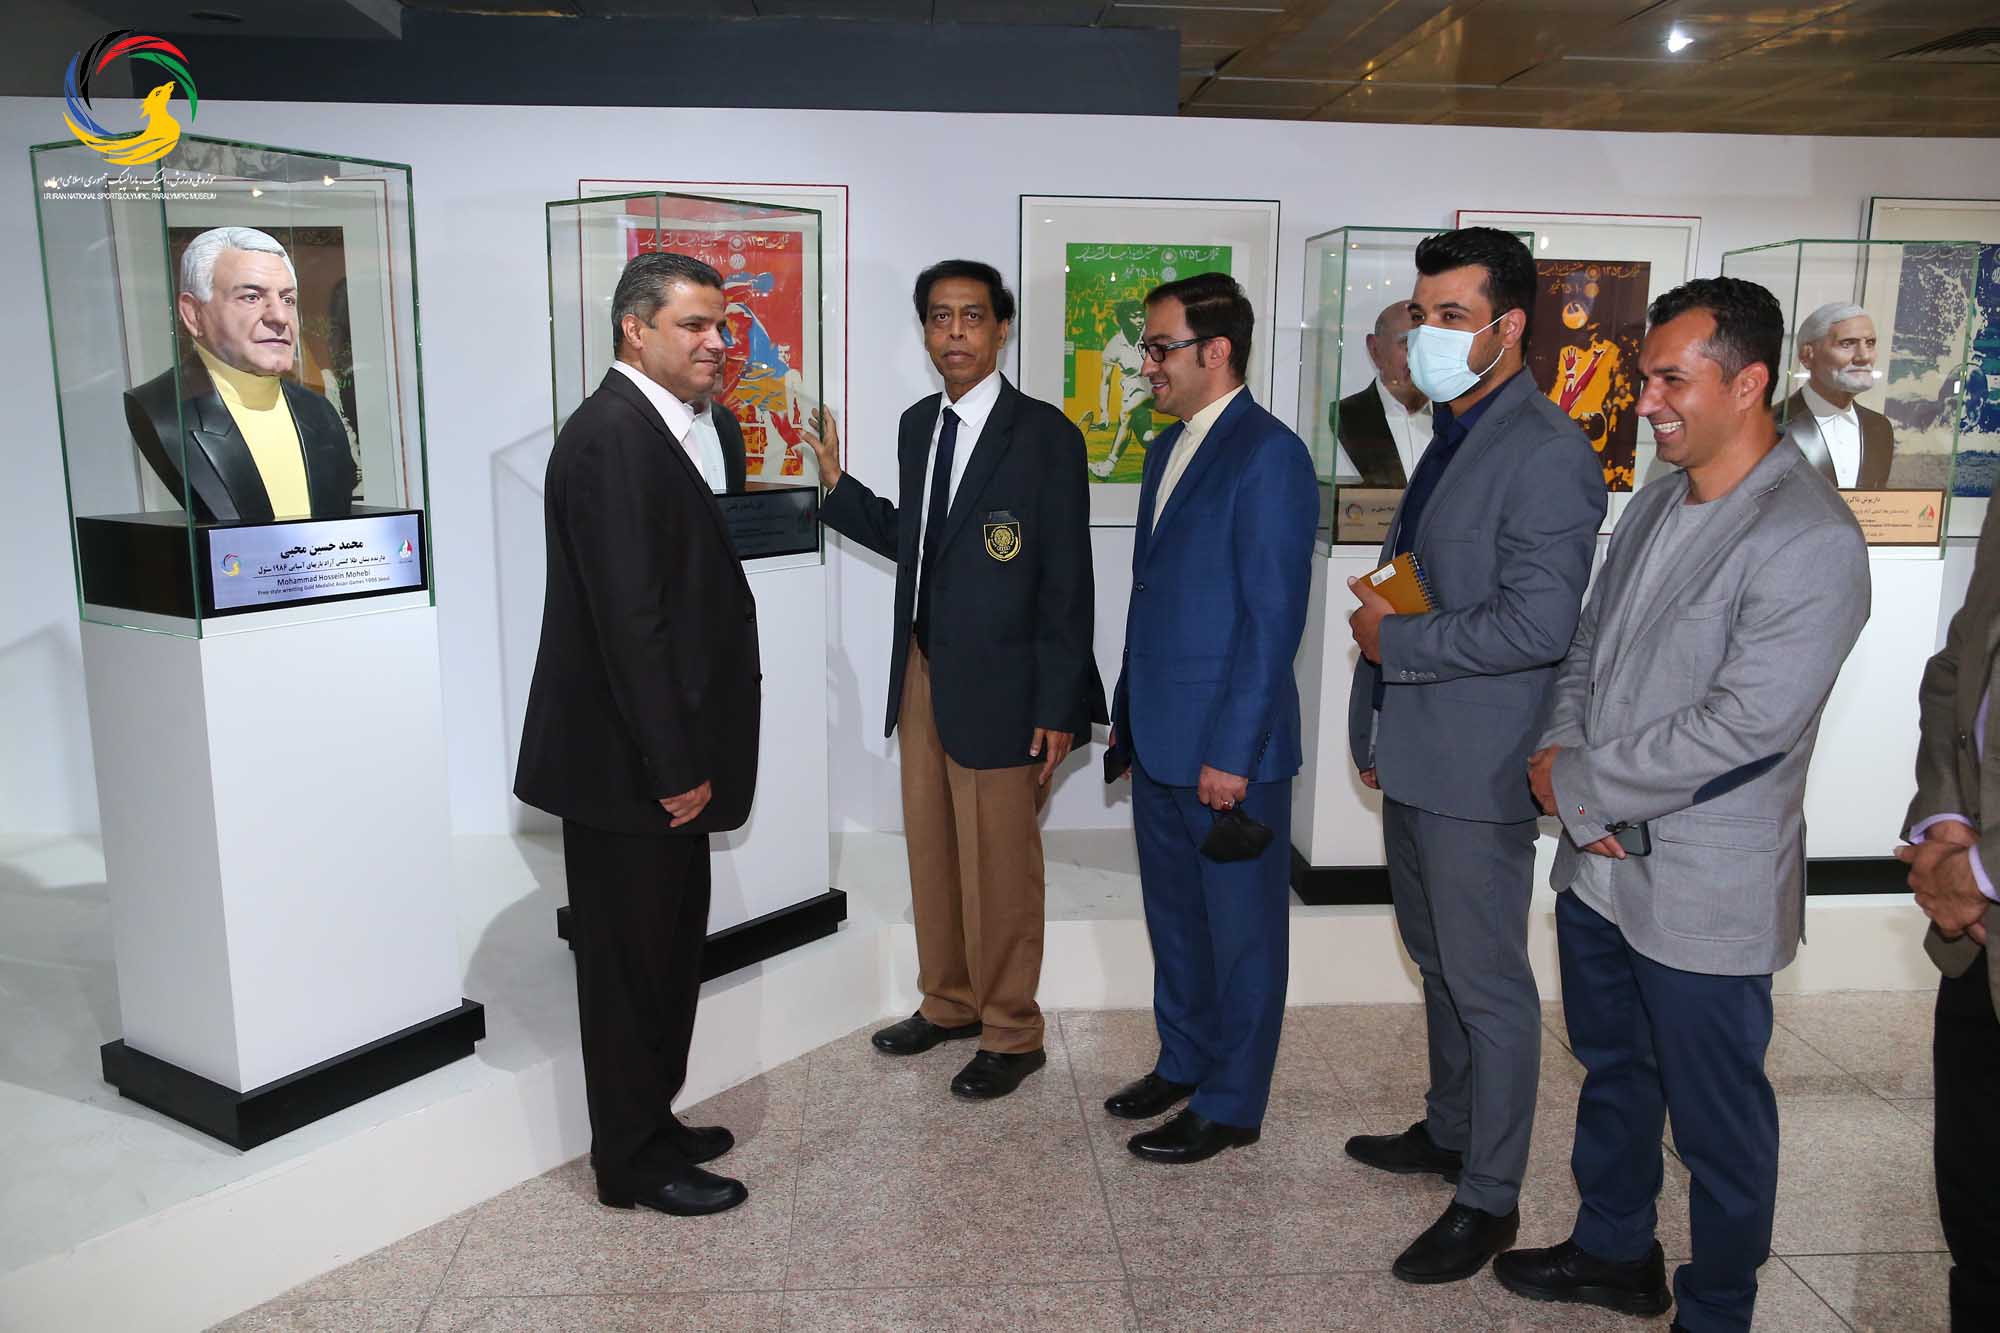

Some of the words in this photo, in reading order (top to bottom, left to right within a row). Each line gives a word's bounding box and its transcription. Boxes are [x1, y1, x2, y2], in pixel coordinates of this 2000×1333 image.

[309, 542, 336, 556] حسین
[339, 539, 364, 551] محمد
[280, 545, 307, 560] محبی
[277, 574, 318, 586] Mohammad
[319, 571, 345, 581] Hossein
